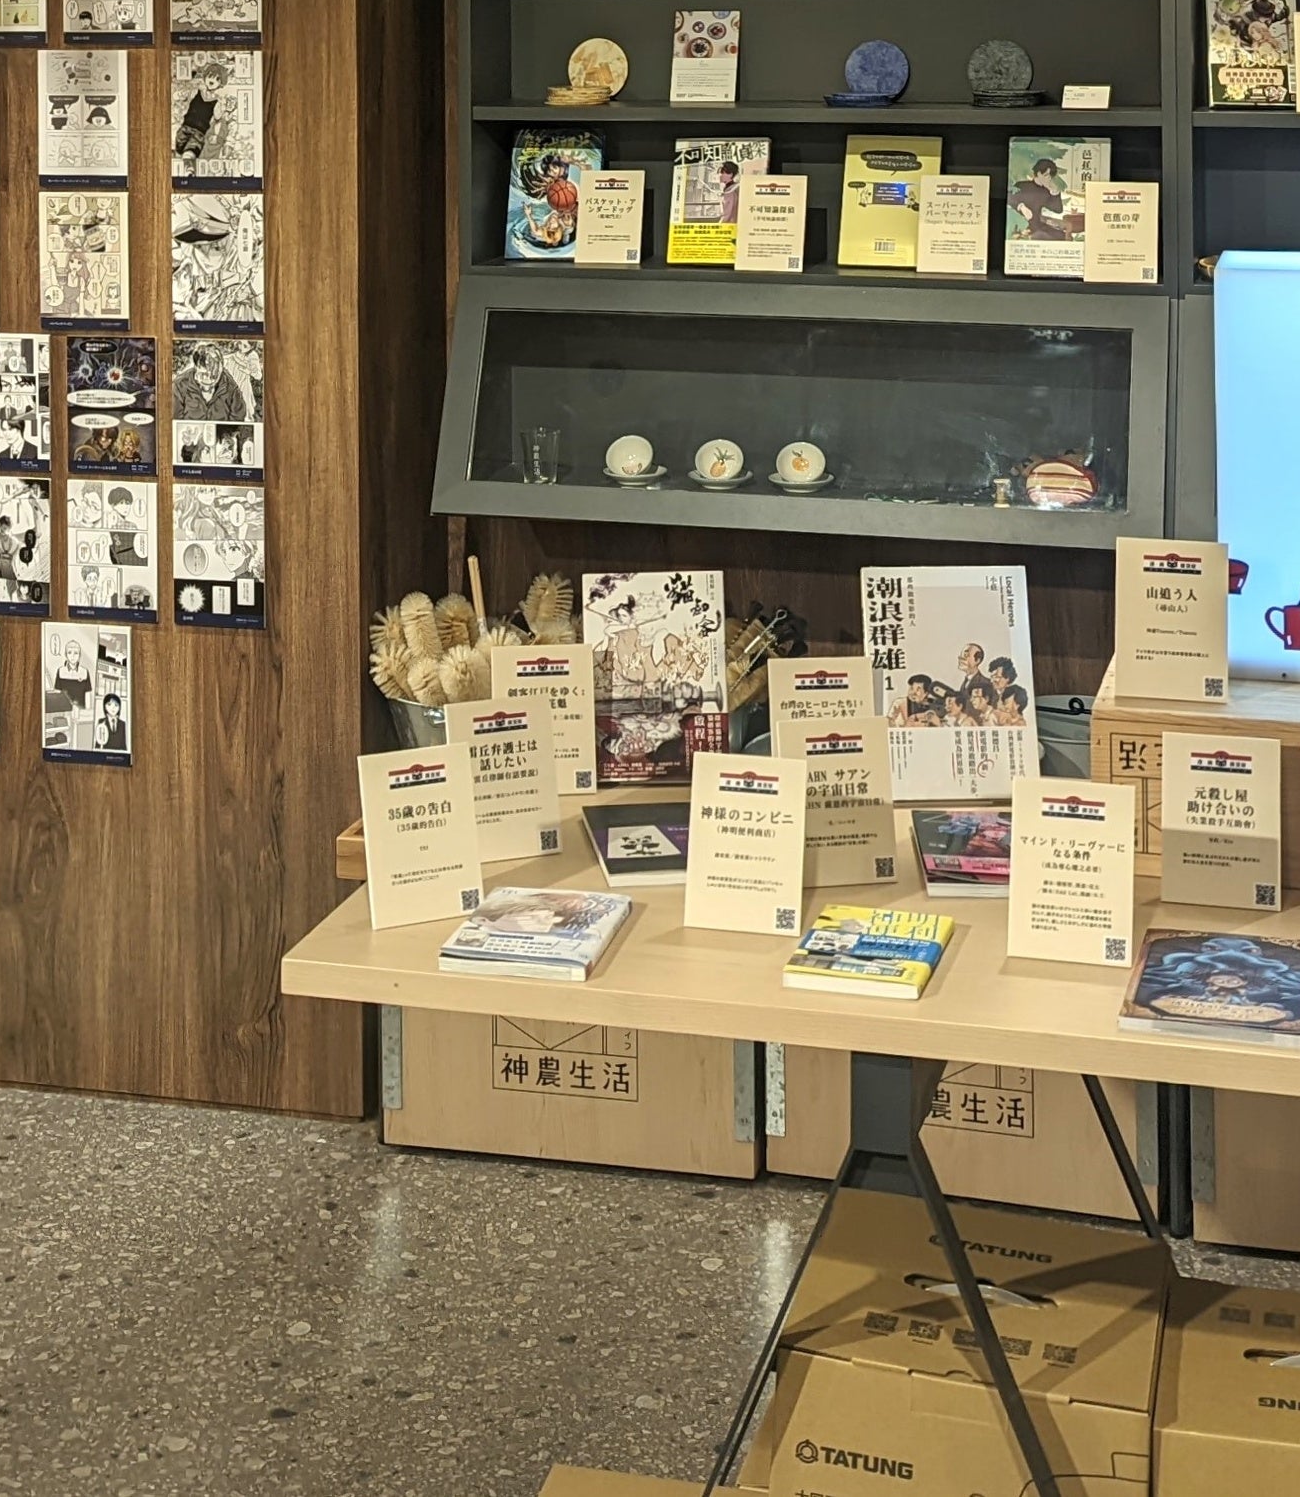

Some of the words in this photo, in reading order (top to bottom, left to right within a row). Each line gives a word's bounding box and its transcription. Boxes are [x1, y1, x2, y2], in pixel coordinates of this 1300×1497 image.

[1081, 149, 1092, 192] 芭蕉的
[1005, 576, 1013, 598] Local
[1146, 586, 1198, 602] 山追う人
[867, 576, 907, 671] 潮浪群雄
[1007, 598, 1015, 628] Heroes
[479, 756, 527, 772] 話したい
[1194, 786, 1248, 803] 元殺し屋
[388, 800, 452, 821] 35歳の告白
[701, 805, 794, 825] 神様のコンビニ
[1187, 800, 1255, 817] 助け合いの
[1053, 848, 1091, 861] なる条件
[499, 1051, 633, 1096] 神農生活
[820, 1446, 914, 1481] TATUNG
